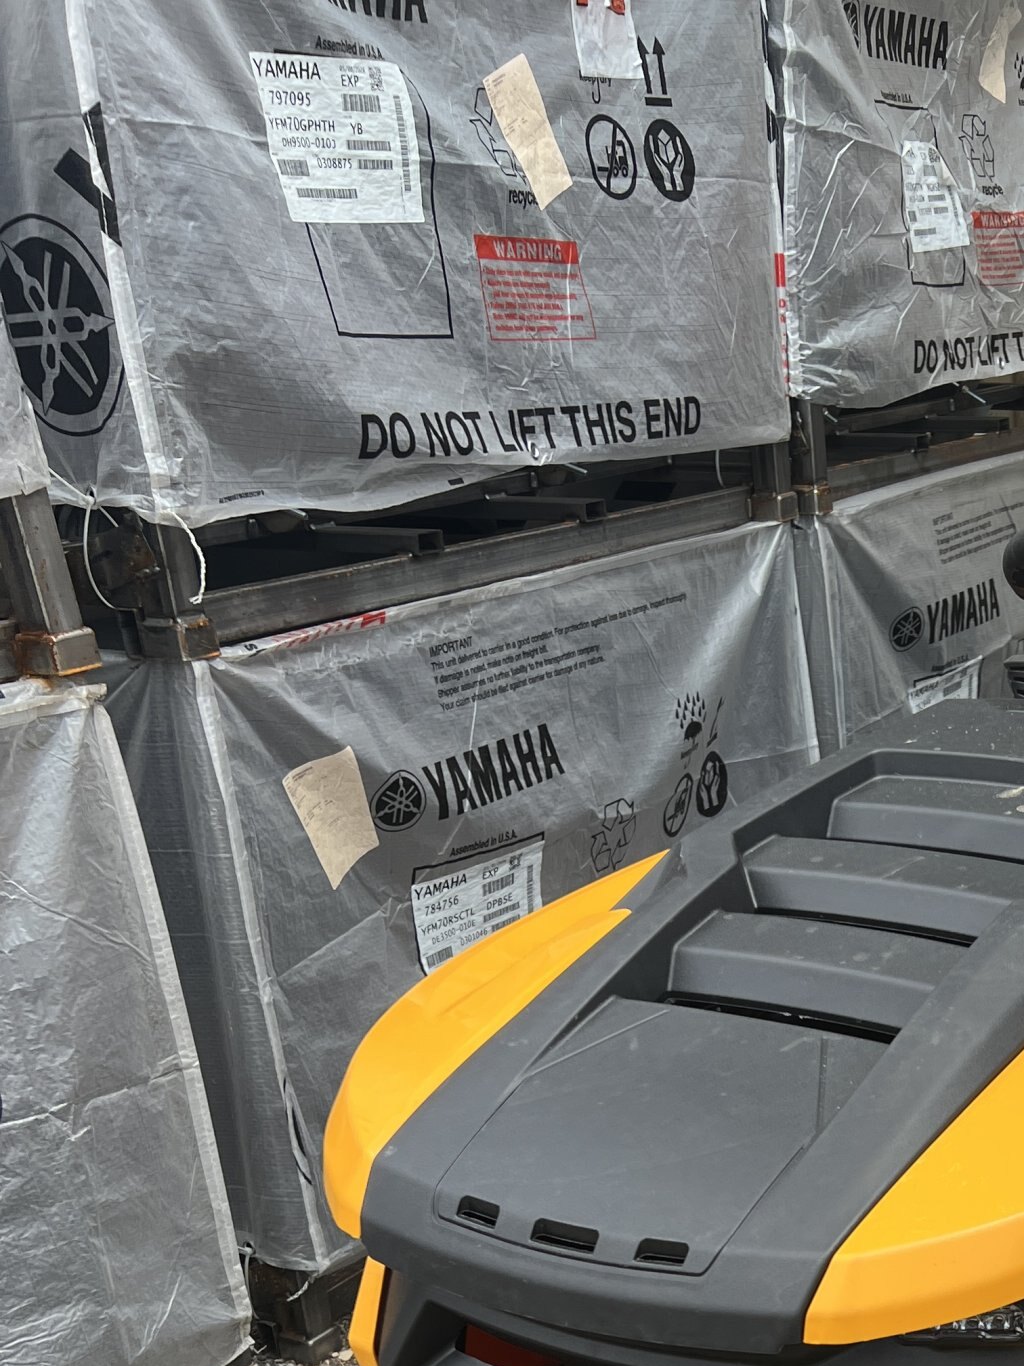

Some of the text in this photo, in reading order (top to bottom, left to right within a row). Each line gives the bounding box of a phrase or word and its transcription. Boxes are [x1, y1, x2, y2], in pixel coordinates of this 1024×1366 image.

[315, 35, 357, 55] Assembled
[358, 41, 365, 56] in
[864, 4, 948, 70] YAMAHA
[252, 58, 321, 80] YAMAHA
[341, 74, 359, 88] EXP
[269, 90, 312, 107] 797095
[269, 117, 363, 135] YFM70GPHTH YB
[317, 157, 352, 170] 0308875
[493, 240, 562, 261] WARNING
[914, 339, 938, 374] DO
[943, 336, 975, 372] NOT
[978, 333, 1010, 366] LIFT
[358, 395, 701, 460] DO NOT LIFT THIS END
[927, 578, 1000, 644] YAMAHA
[429, 636, 472, 658] IMPORTANT
[458, 649, 482, 664] delivered
[440, 671, 463, 683] damage
[438, 686, 459, 698] Shipper
[456, 697, 470, 707] claim
[422, 723, 565, 820] YAMAHA
[449, 840, 489, 857] Assembled
[414, 867, 499, 900] YAMAHA EXP
[425, 895, 459, 916] 784756
[421, 907, 476, 936] YFM70RSCTL
[460, 928, 488, 946] 0301046
